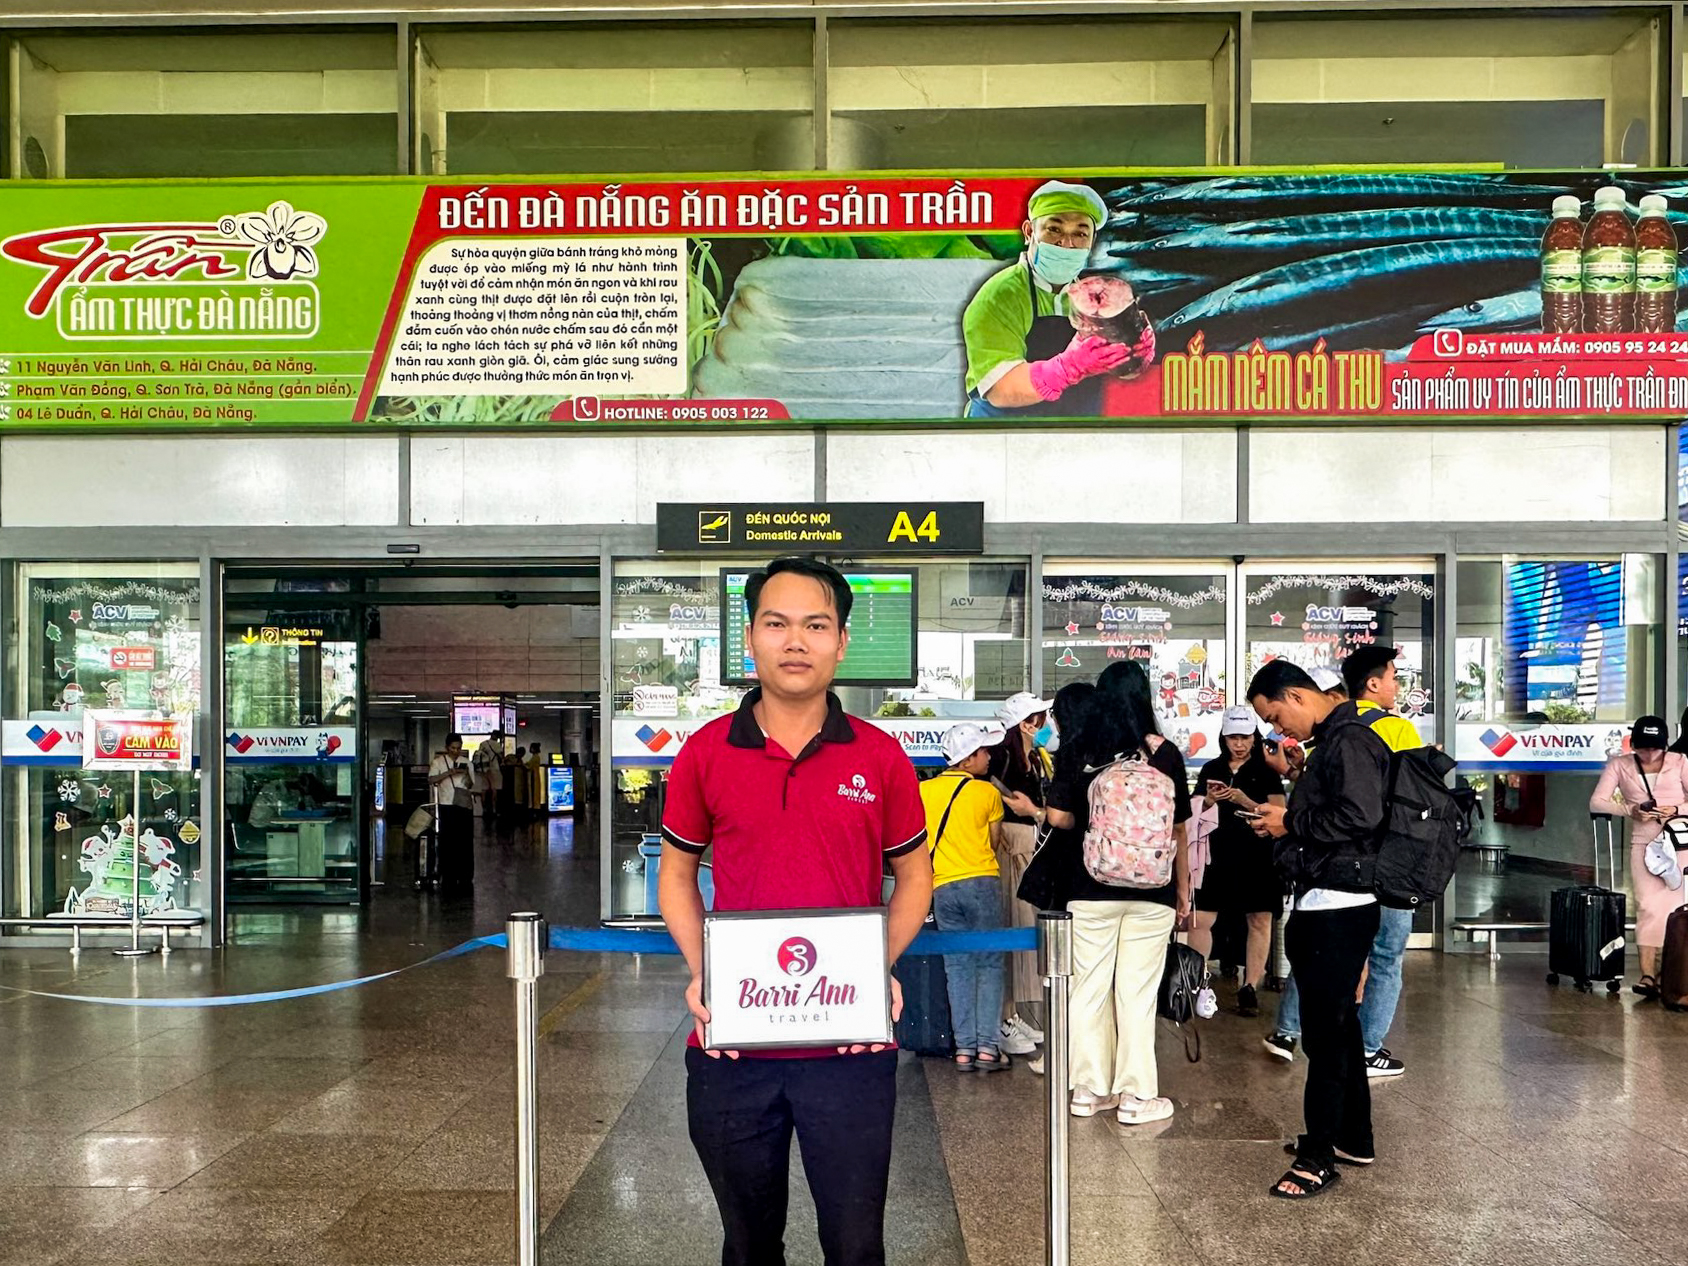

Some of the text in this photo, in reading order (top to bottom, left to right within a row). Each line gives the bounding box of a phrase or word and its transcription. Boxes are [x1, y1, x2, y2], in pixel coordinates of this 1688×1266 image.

[438, 180, 992, 229] ĐẾN ĐÀ NẴNG ĂN ĐẶC SẢN TRẦN
[451, 248, 466, 261] Sự
[467, 248, 489, 258] hòa
[529, 247, 555, 260] giữa
[557, 247, 586, 257] bánh
[589, 247, 619, 259] tráng
[621, 247, 642, 257] khô
[644, 245, 678, 258] mỏng
[429, 264, 458, 276] được
[484, 263, 506, 273] vào
[511, 261, 547, 275] miếng
[552, 262, 570, 275] mỳ
[575, 262, 586, 273] lá
[592, 263, 614, 272] như
[618, 262, 647, 272] hành
[652, 262, 677, 272] trình
[451, 279, 467, 289] vời
[487, 277, 513, 288] cảm
[515, 278, 544, 291] nhận
[547, 277, 571, 288] món
[574, 277, 589, 287] ăn
[591, 279, 621, 289] ngon
[623, 277, 637, 287] và
[640, 277, 657, 287] khi
[658, 279, 677, 287] rau
[415, 291, 678, 306] xanh cùng thịt được đặt lên rồi cuộn tròn lại,
[70, 286, 311, 335] ẨM THỰC ĐÀ NẴNG
[1466, 340, 1496, 358] ĐẶT
[1501, 341, 1534, 354] MUA
[1538, 336, 1581, 354] MẮM:
[1584, 341, 1621, 353] 0905
[1624, 341, 1644, 354] 95
[1647, 341, 1666, 353] 24
[17, 361, 31, 372] 11
[37, 358, 88, 375] Nguyễn
[93, 360, 120, 372] Văn
[125, 360, 155, 373] Linh,
[160, 360, 174, 372] Q.
[180, 358, 202, 372] Hải
[207, 359, 248, 373] Châu,
[253, 359, 271, 371] Đà
[1163, 331, 1381, 411] MẮM NÊM CÁ THU
[391, 372, 419, 384] hạnh
[421, 371, 450, 383] phúc
[452, 371, 481, 383] được
[525, 370, 550, 381] thức
[552, 370, 578, 381] món
[580, 371, 594, 380] ăn
[597, 370, 618, 383] trọn
[621, 370, 634, 383] vị.
[17, 384, 55, 399] Phạm
[60, 384, 86, 396] Văn
[136, 384, 151, 396] Q.
[155, 384, 179, 395] Sơn
[184, 383, 209, 396] Trà,
[213, 383, 232, 395] Đà
[1391, 369, 1421, 410] SẢN
[1425, 366, 1469, 409] PHẨM
[1472, 378, 1492, 409] UY
[1495, 370, 1519, 409] TÍN
[1523, 369, 1552, 409] CỦA
[1555, 365, 1581, 408] ẨM
[1584, 373, 1623, 412] THỰC
[1626, 365, 1665, 409] TRẦN
[17, 408, 33, 419] 04
[37, 407, 52, 419] Lê
[100, 408, 116, 419] Q.
[120, 405, 143, 419] Hải
[147, 406, 188, 421] Châu,
[193, 406, 212, 418] Đà
[604, 407, 768, 419] HOTLINE: 0905 003 122
[887, 511, 940, 543] A4
[746, 530, 842, 541] Domestic Arrivals
[950, 597, 975, 607] ACV
[93, 604, 127, 619] ACV
[670, 606, 705, 620] ACV
[1102, 607, 1137, 620] ACV
[1307, 607, 1342, 620] ACV
[281, 628, 323, 637] THÔNG TIN
[256, 736, 309, 747] Ví VNPAY
[1520, 735, 1595, 748] Ví VNPAY
[738, 975, 858, 1009] Barri Ann
[769, 1010, 829, 1024] travel
